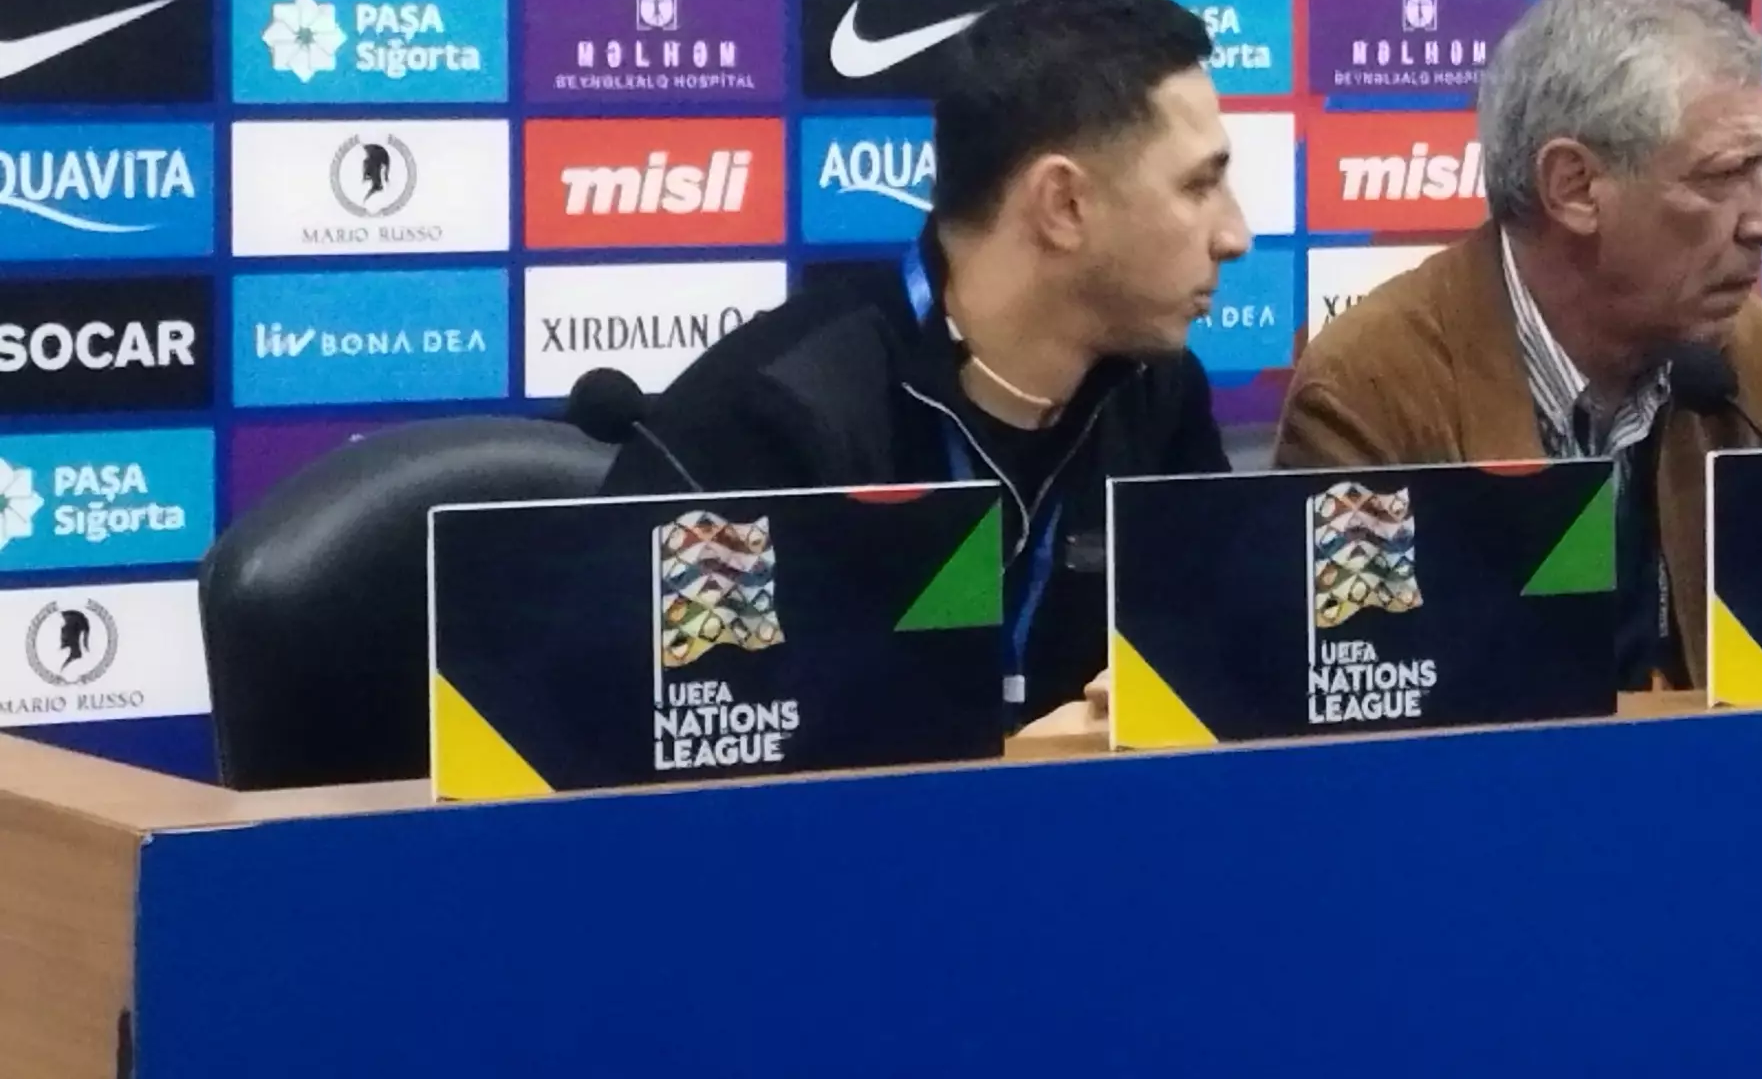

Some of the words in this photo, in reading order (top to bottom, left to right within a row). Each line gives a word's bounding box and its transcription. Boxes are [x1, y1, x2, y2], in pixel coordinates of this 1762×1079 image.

[354, 4, 443, 40] PAŞA
[1203, 6, 1241, 39] ŞA
[577, 39, 736, 68] MƏLHƏM
[1209, 42, 1271, 68] orta
[0, 148, 194, 203] QUAVITA
[819, 140, 937, 189] AQUA
[1338, 141, 1486, 200] misl
[560, 150, 750, 216] misli
[301, 227, 367, 244] MARIO
[378, 225, 443, 242] RUSSO
[540, 313, 707, 352] XIRDALAN
[1221, 305, 1274, 329] DEA
[0, 318, 194, 374] SOCAR
[320, 331, 411, 358] BONA
[422, 328, 485, 355] DEA
[50, 464, 145, 505] PAŞA
[1321, 640, 1377, 665] UEFA
[668, 680, 734, 707] UEFA
[1308, 659, 1437, 694] NATIONS
[76, 690, 144, 710] RUSSO
[1308, 690, 1422, 724] LEAGUE
[654, 700, 800, 740] NATIONS
[654, 732, 786, 770] LEAGUE
